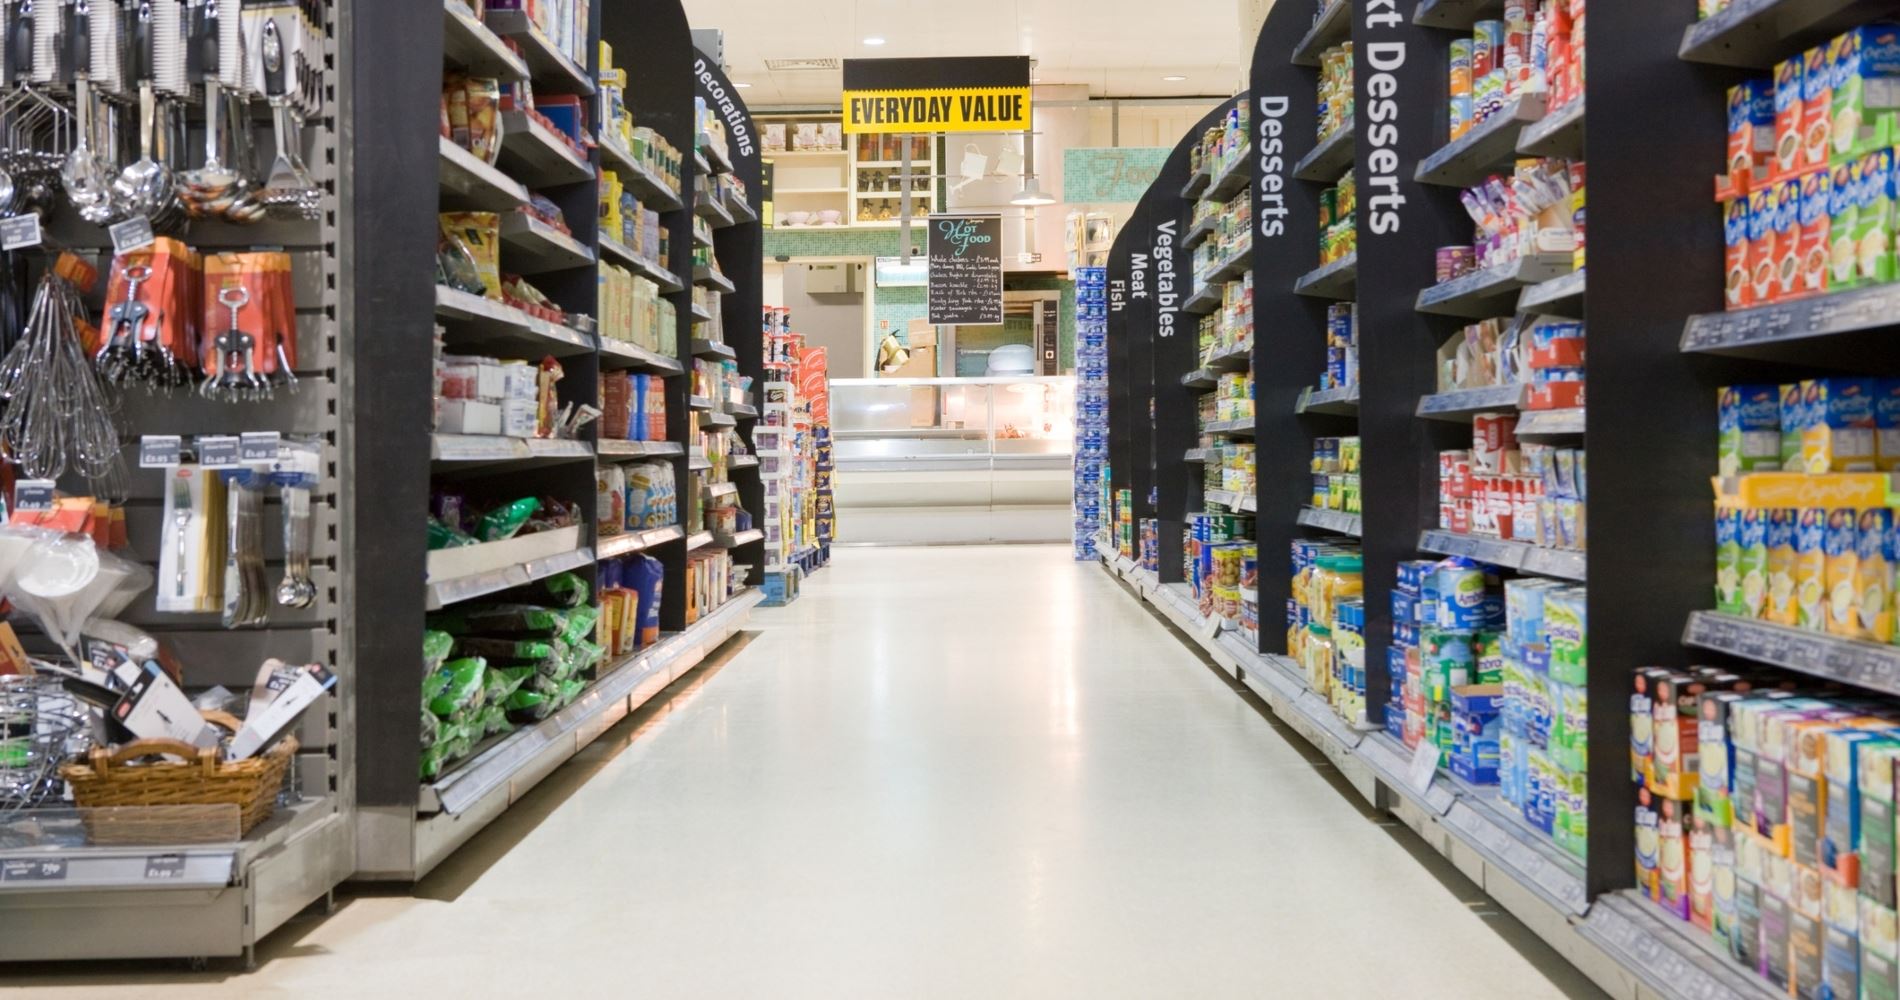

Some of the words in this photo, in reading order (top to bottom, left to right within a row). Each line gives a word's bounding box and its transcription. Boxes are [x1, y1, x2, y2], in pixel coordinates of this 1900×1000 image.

[694, 58, 754, 157] Decorations
[851, 96, 952, 124] EVERYDAY
[959, 94, 1023, 122] VALUE
[1366, 42, 1407, 235] Desserts
[1259, 96, 1289, 238] Desserts
[1110, 279, 1126, 312] Fish
[1130, 253, 1149, 299] Meat
[1153, 219, 1179, 337] Vegetables
